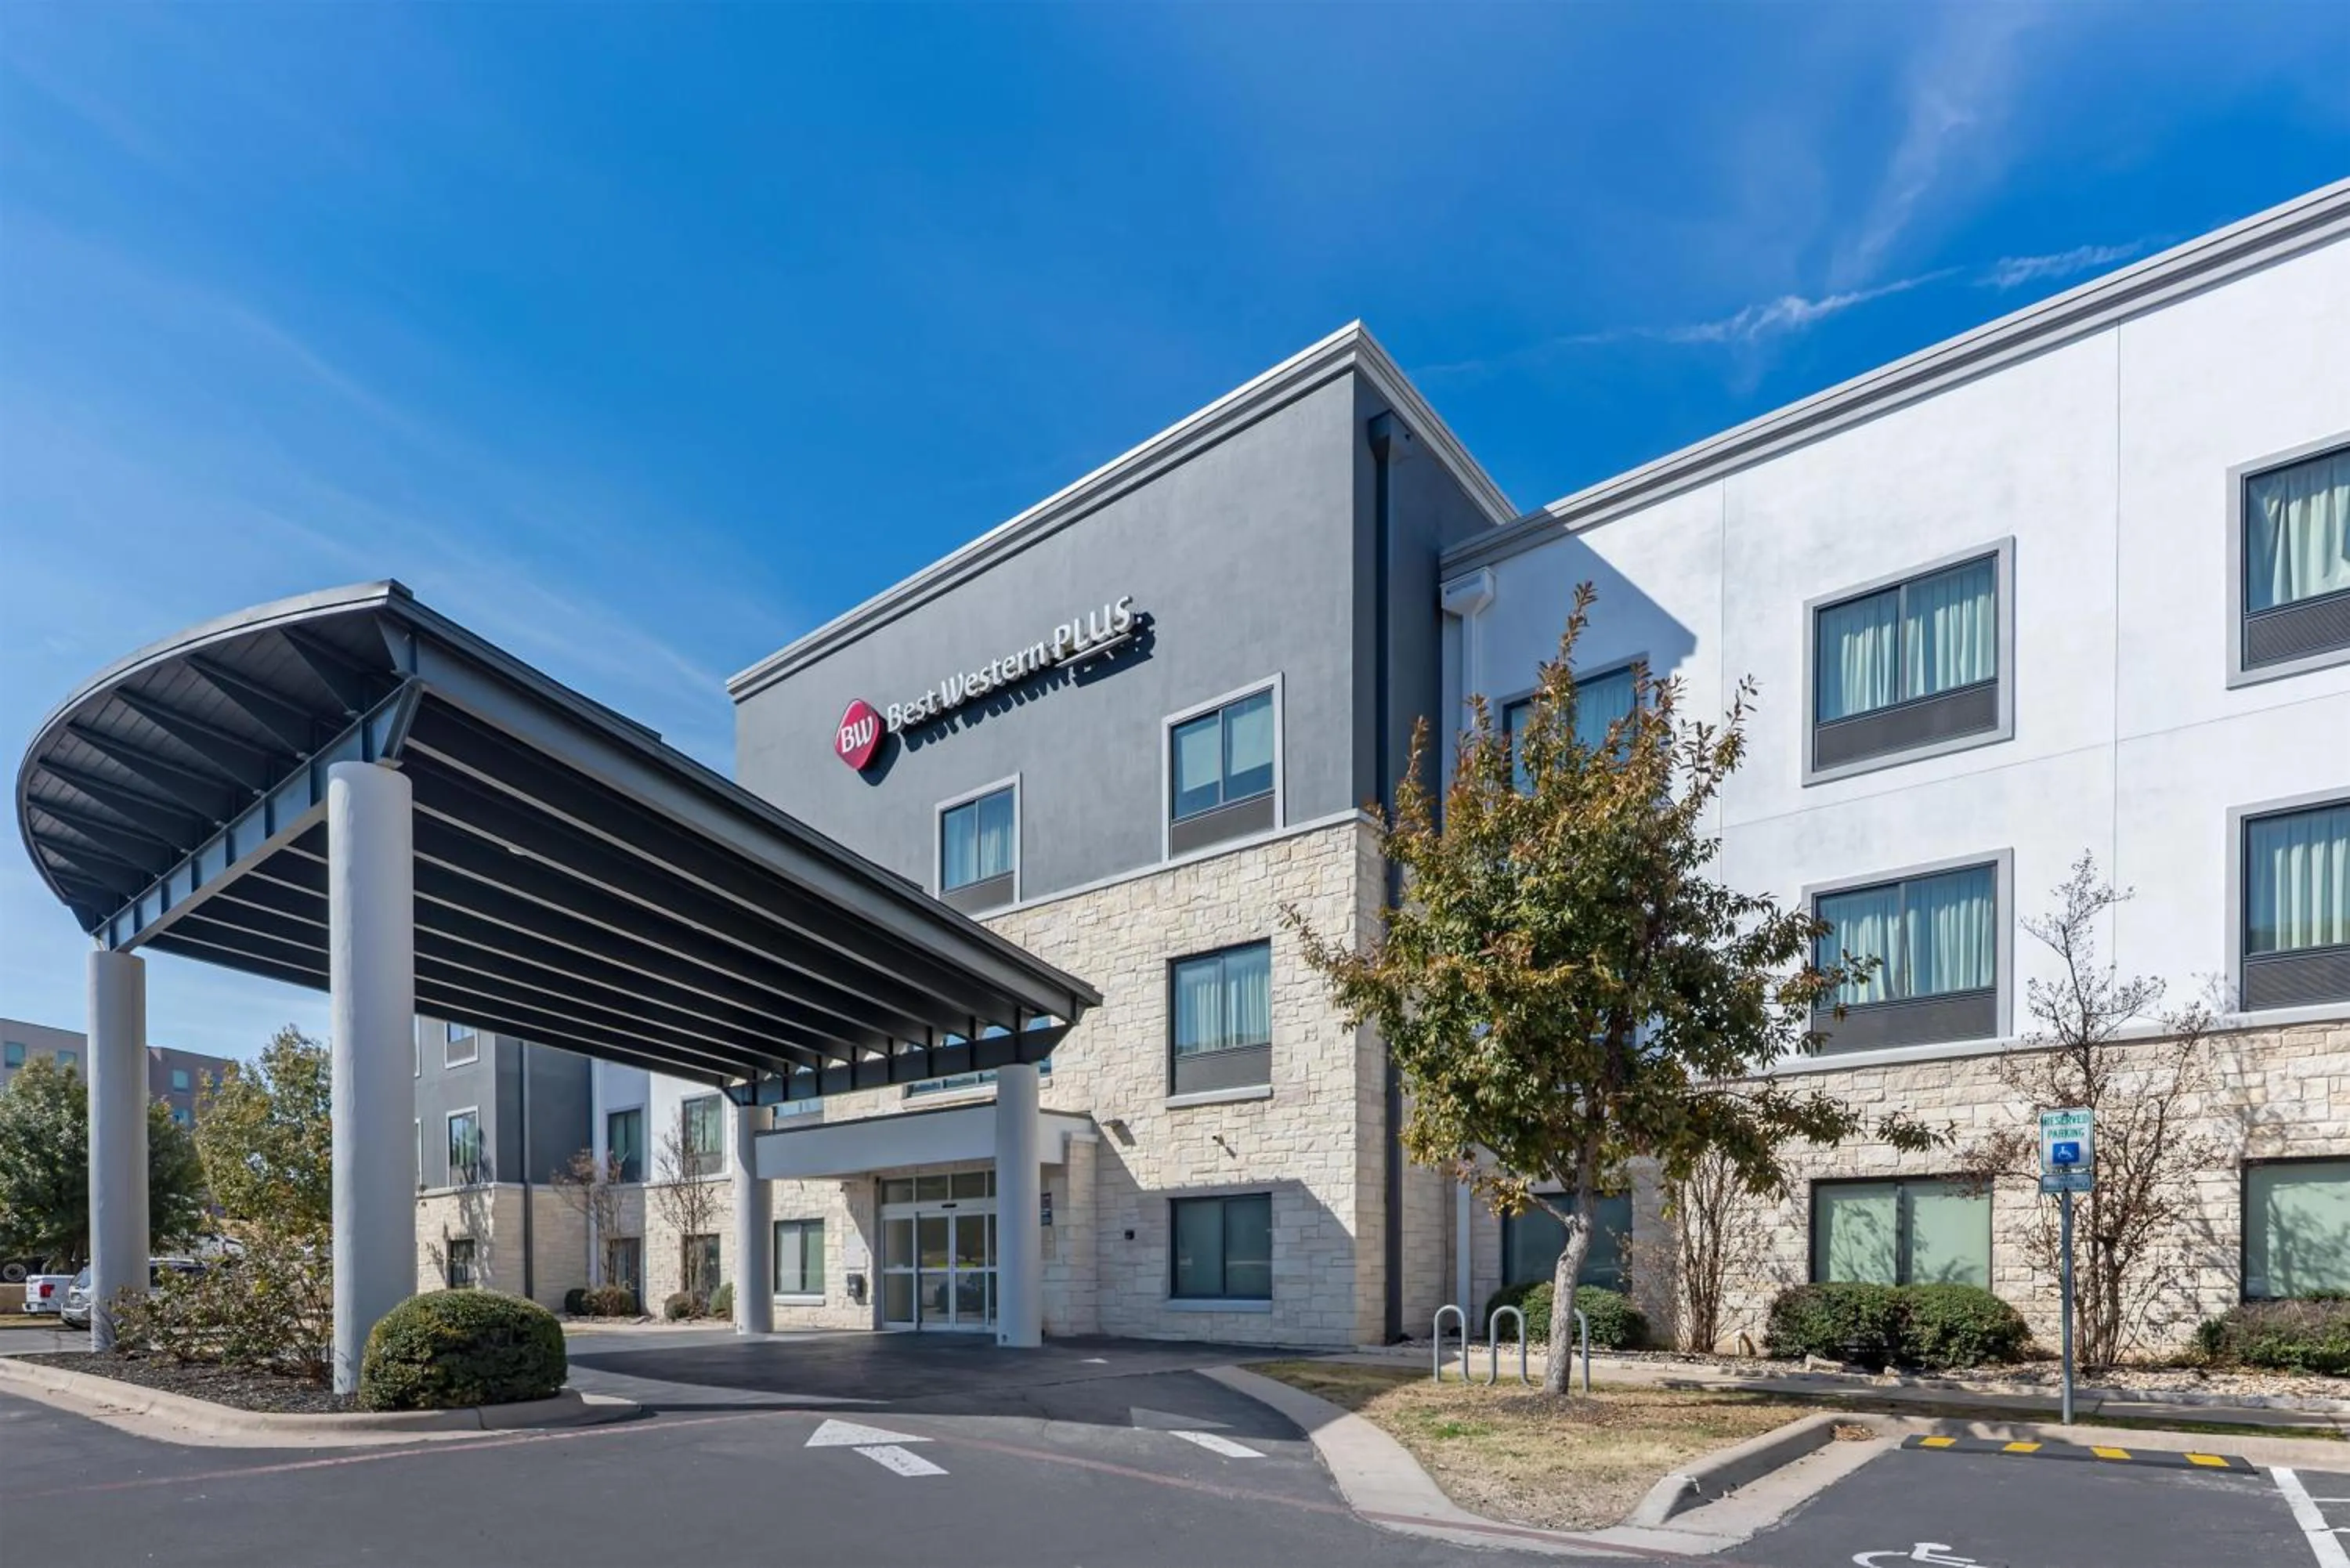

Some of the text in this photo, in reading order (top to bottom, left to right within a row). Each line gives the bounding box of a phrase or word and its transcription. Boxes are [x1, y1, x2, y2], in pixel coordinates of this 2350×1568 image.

[887, 595, 1134, 733] Best Western PLUS
[841, 715, 874, 753] BW
[2042, 1114, 2090, 1126] RESERVED
[2047, 1128, 2085, 1139] PARKING
